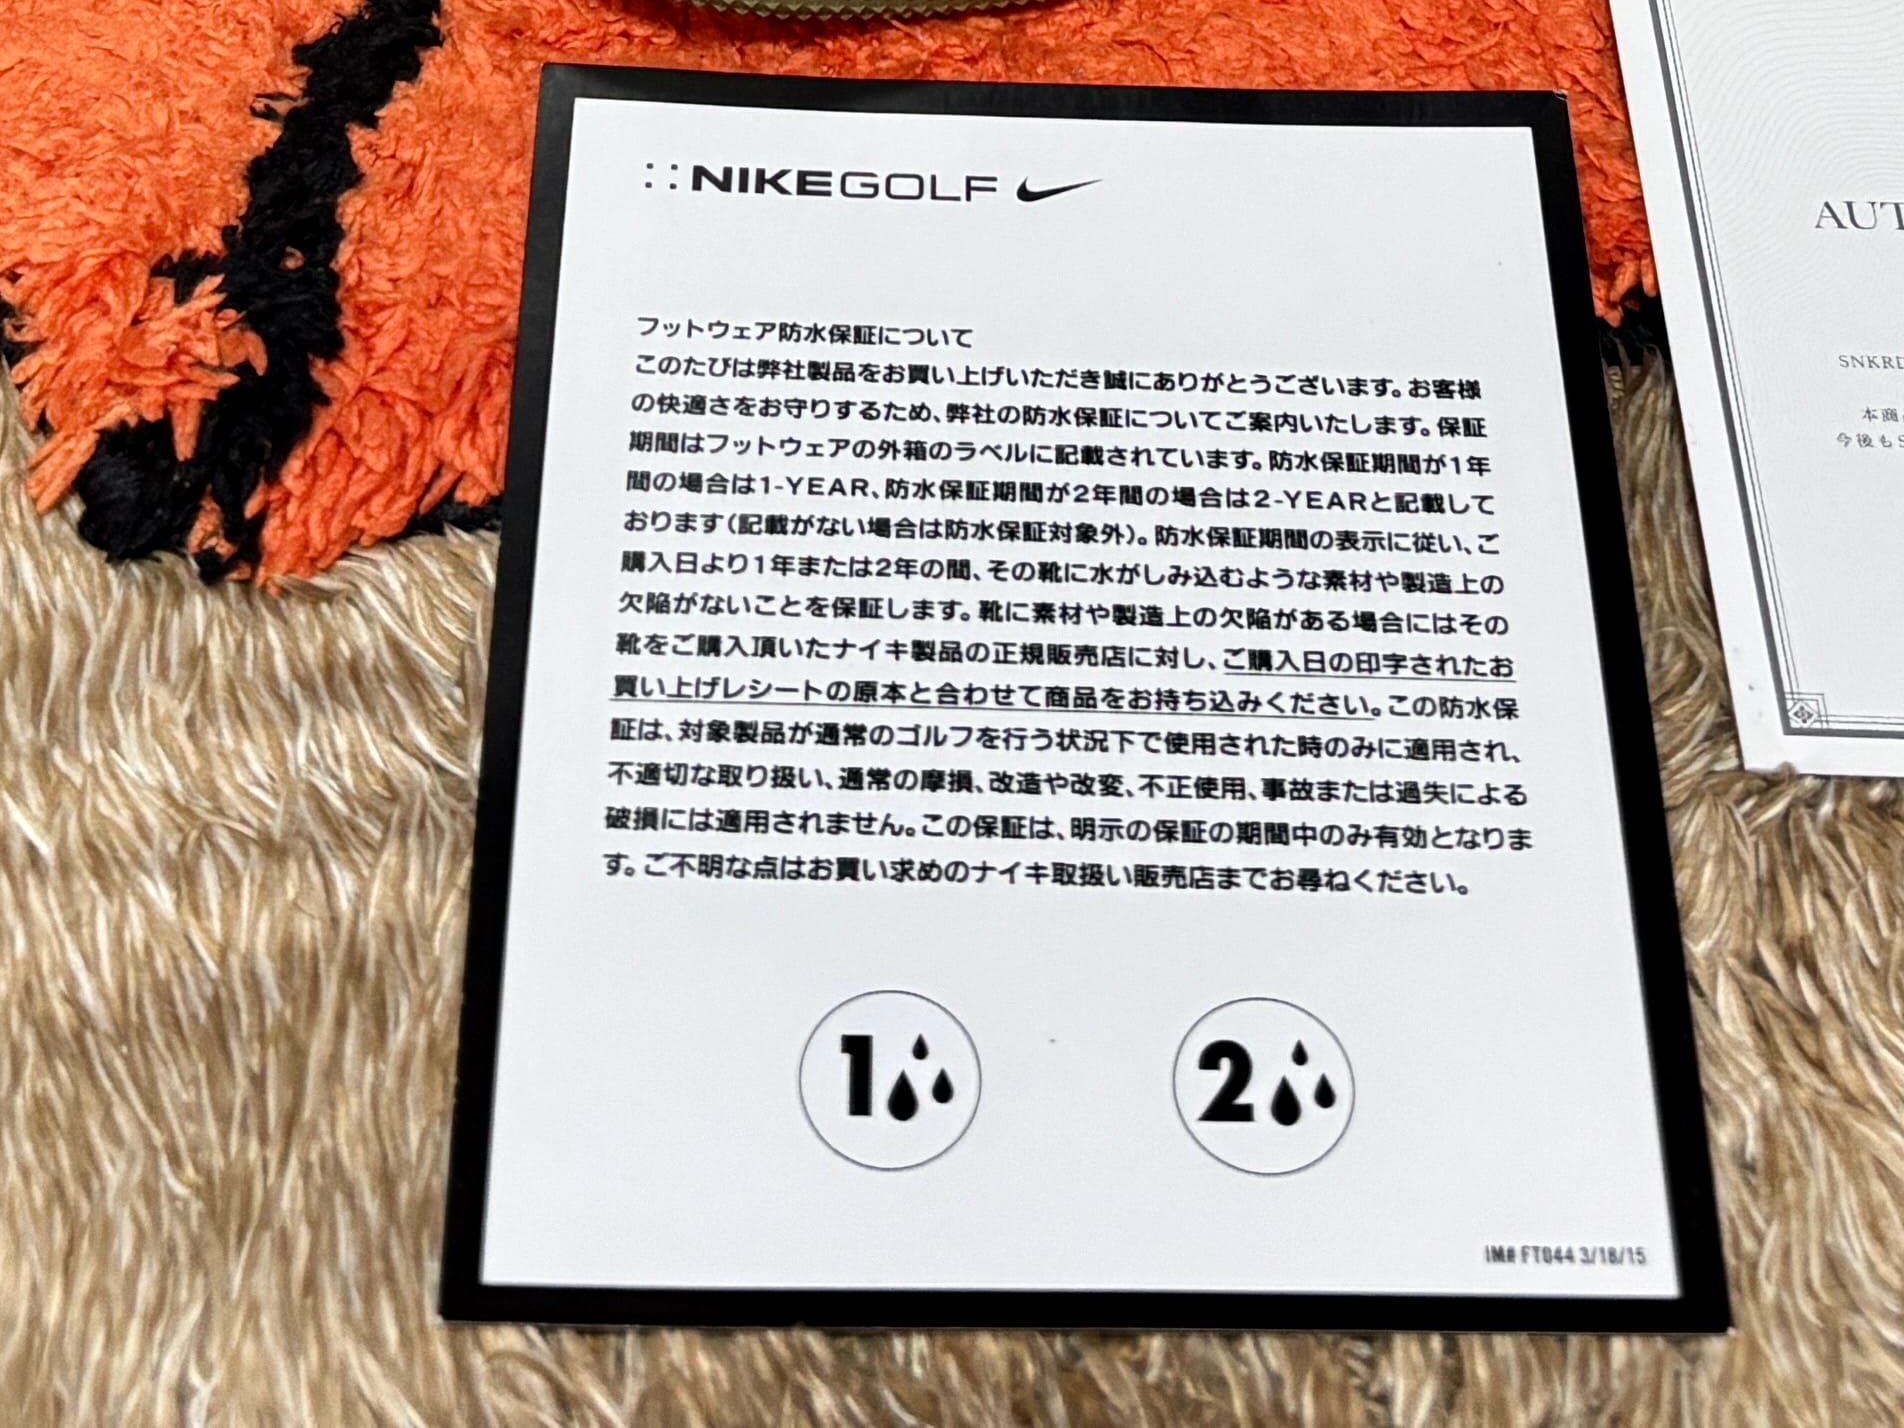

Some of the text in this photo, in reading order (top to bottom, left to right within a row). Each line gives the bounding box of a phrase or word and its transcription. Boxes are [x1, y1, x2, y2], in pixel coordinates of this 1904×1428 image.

[636, 316, 974, 350] フットウェア防水保証について
[840, 1034, 873, 1117] 1
[1197, 1039, 1256, 1123] 2
